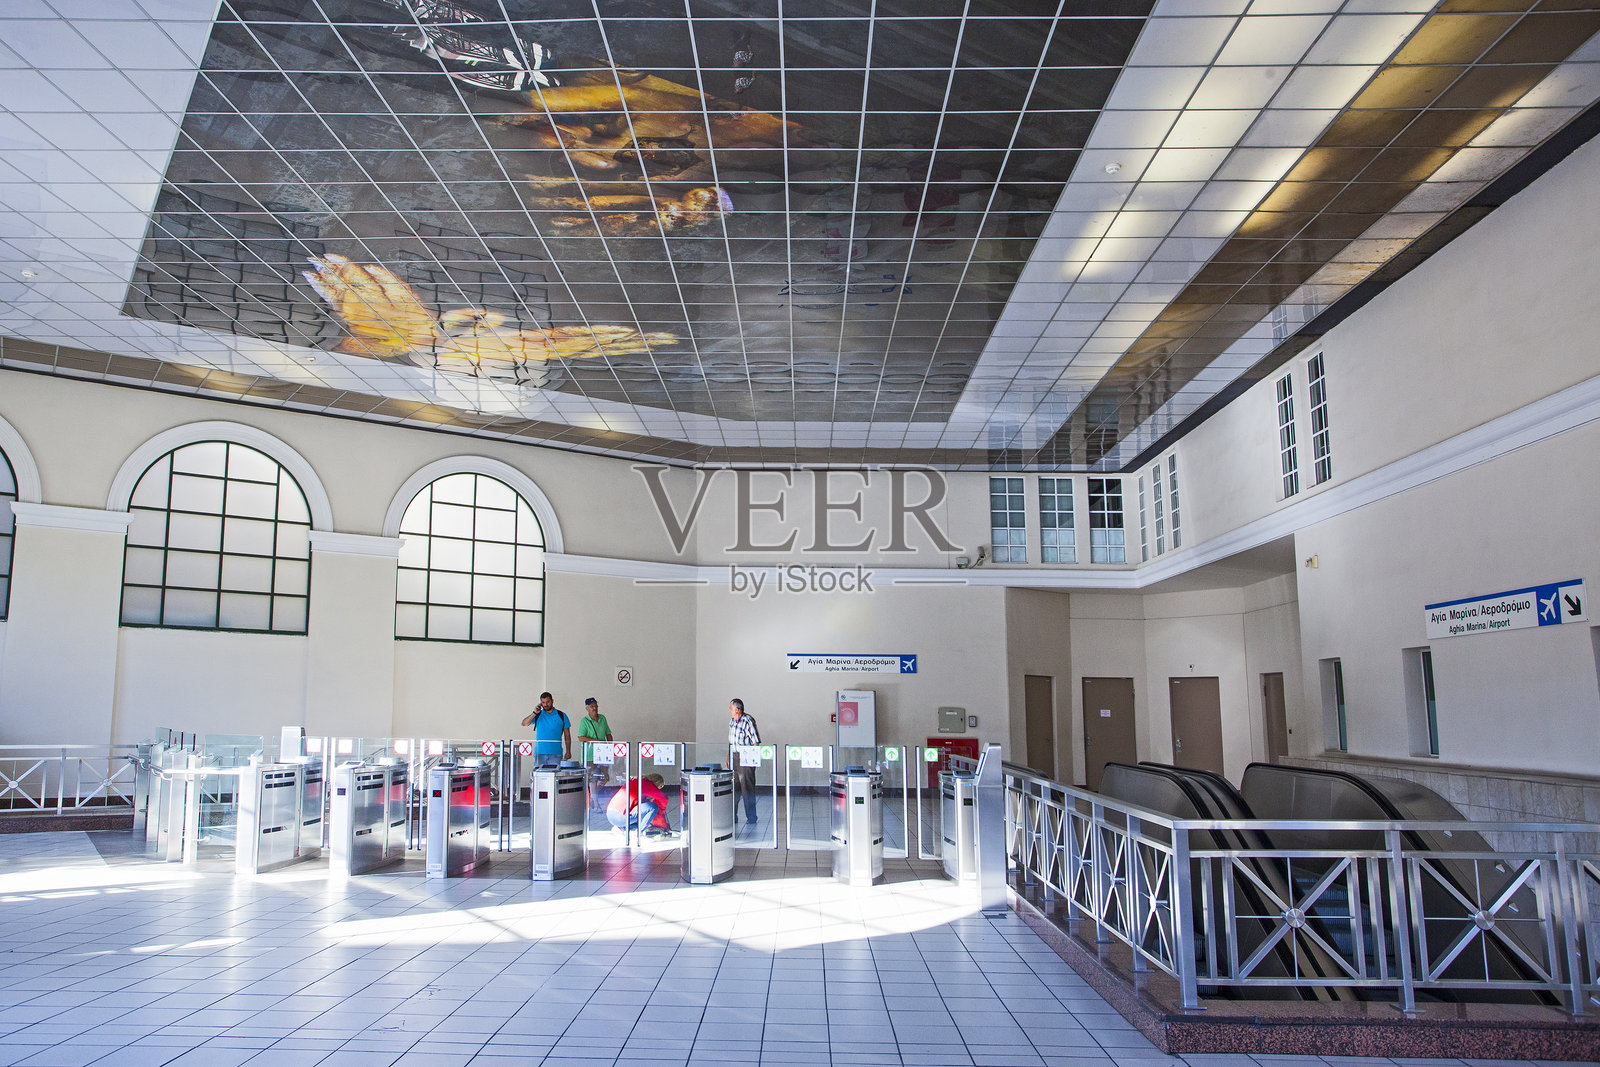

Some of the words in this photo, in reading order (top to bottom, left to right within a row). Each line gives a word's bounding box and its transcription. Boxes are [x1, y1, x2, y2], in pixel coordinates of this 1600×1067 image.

[1430, 611, 1447, 624] Αγία
[1448, 623, 1465, 635] Aghia
[808, 658, 823, 666] Αγία
